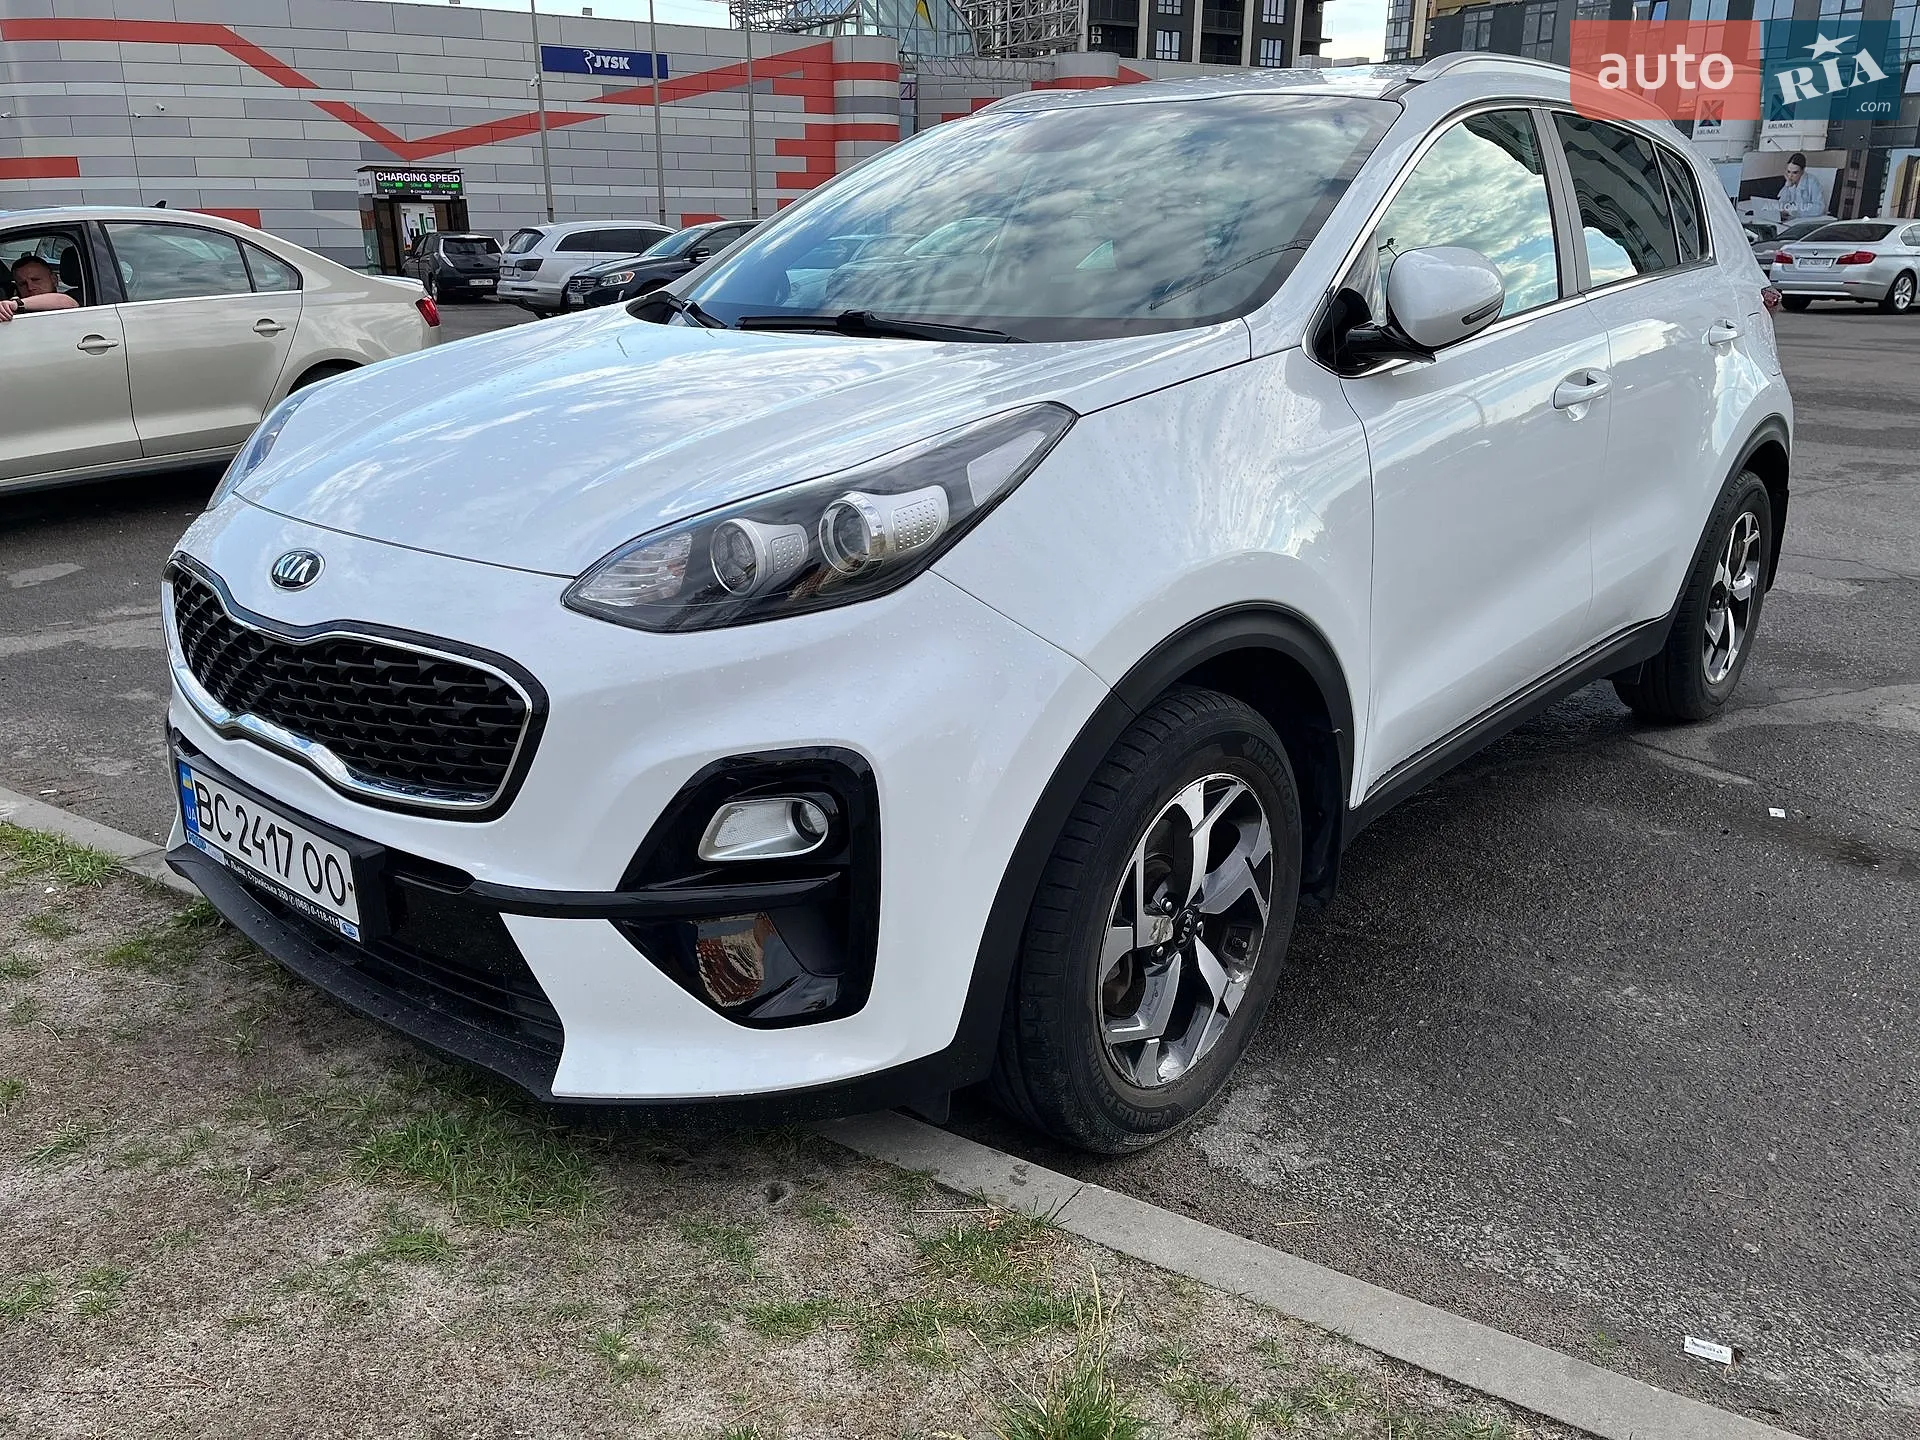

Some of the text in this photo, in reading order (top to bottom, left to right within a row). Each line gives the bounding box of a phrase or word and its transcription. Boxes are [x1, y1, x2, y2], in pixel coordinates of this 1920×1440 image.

[594, 55, 630, 70] JYSK
[376, 172, 428, 183] CHARGING
[429, 173, 460, 183] SPEED
[273, 553, 314, 583] KIA
[185, 804, 198, 823] UA
[194, 779, 233, 842] BC
[235, 804, 294, 879] 2417
